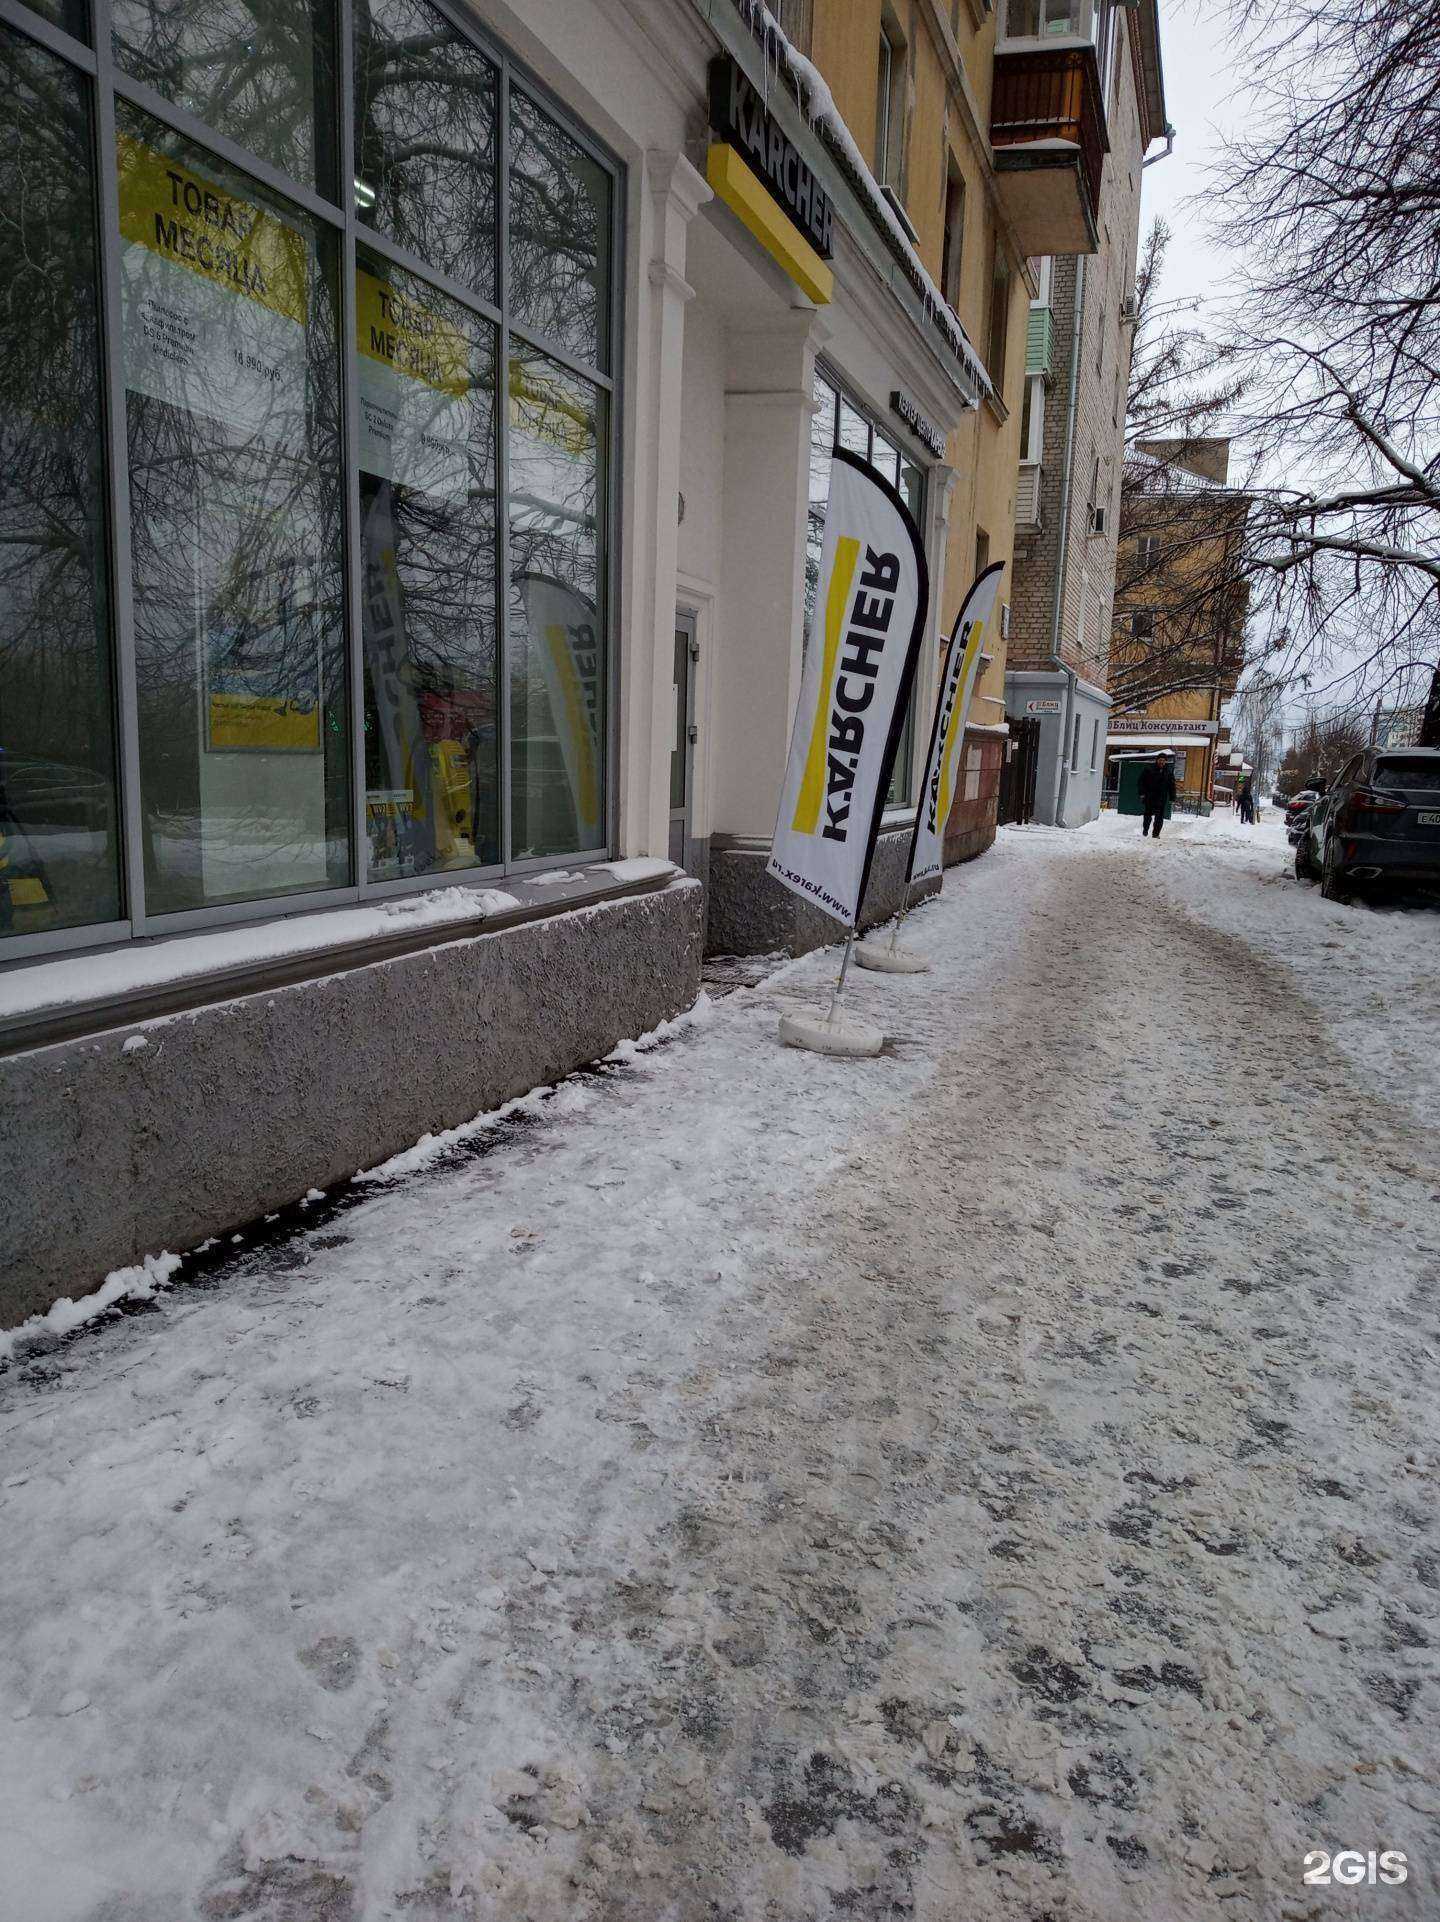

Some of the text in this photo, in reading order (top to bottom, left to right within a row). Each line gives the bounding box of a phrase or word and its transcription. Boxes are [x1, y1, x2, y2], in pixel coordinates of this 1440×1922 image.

[154, 212, 267, 297] МЕСЯЦА
[1113, 720, 1207, 732] Блиц Консультант
